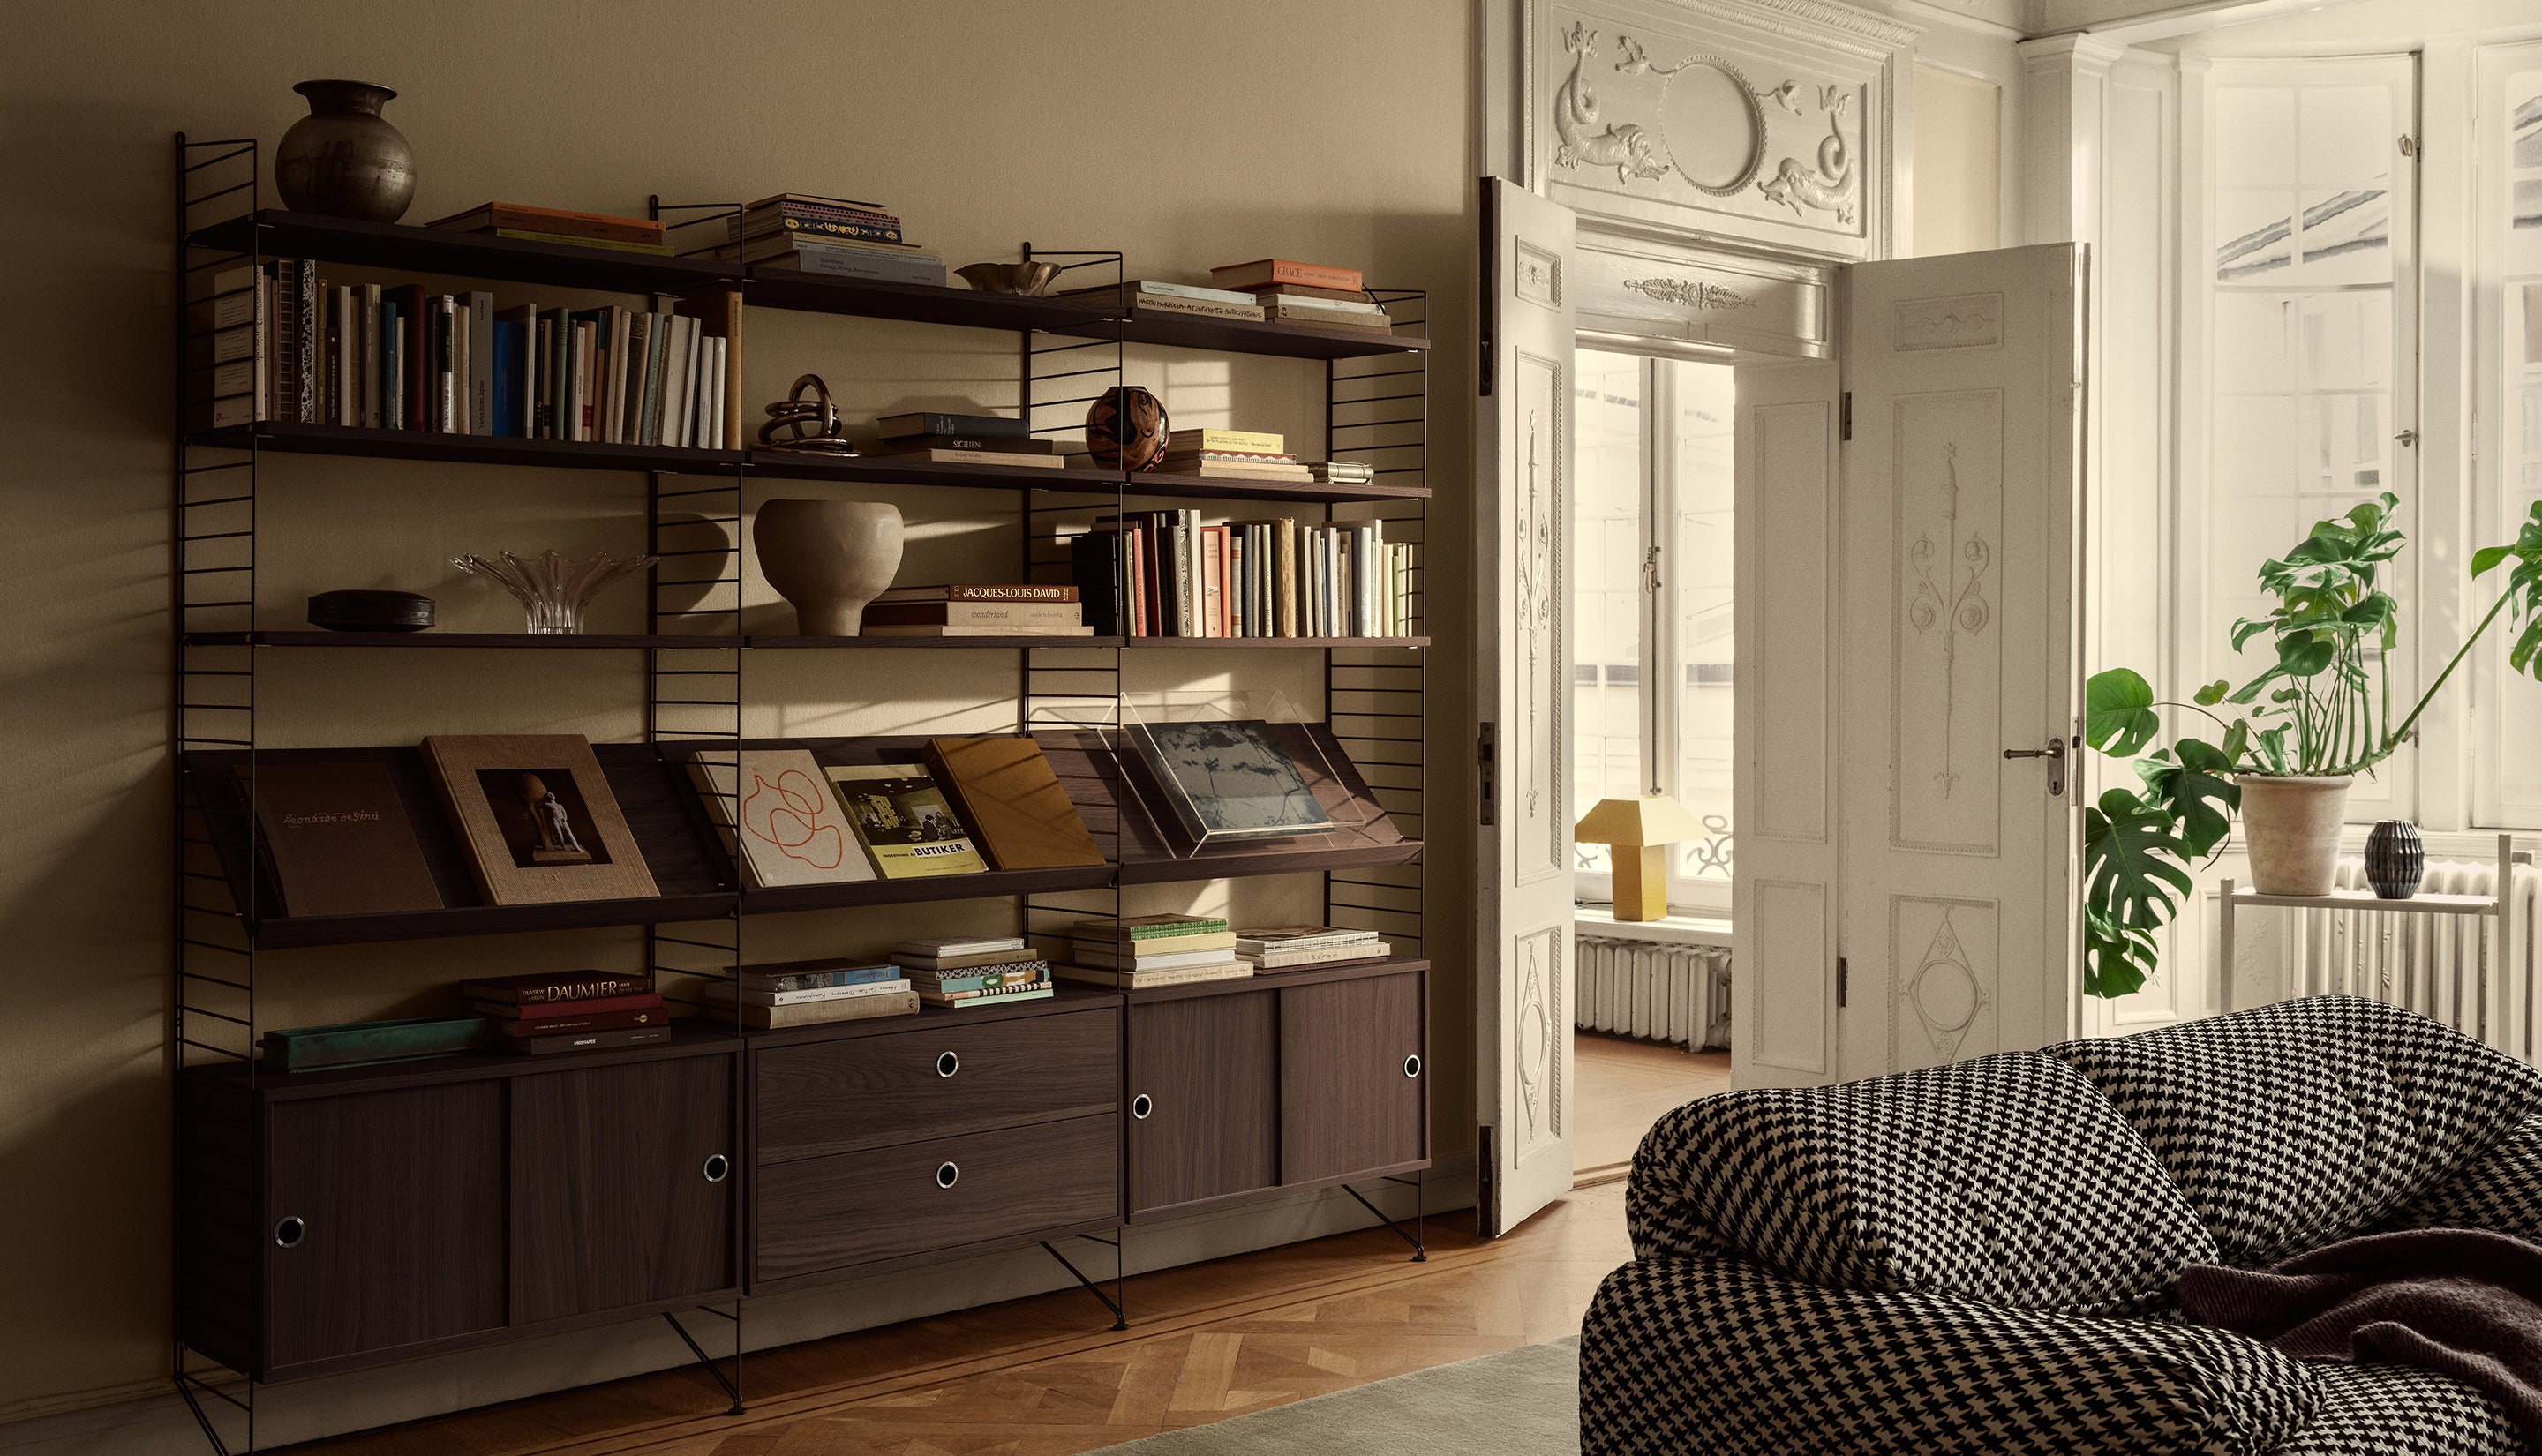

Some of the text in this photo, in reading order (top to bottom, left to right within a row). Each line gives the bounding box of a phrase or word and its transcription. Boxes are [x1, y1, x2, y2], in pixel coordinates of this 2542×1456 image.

[1277, 266, 1302, 278] GRACE
[963, 587, 1032, 599] JACQUES-LOUIS
[1034, 589, 1060, 598] DAVID
[914, 844, 965, 856] BUTIKER
[547, 980, 618, 1002] DAUMIER
